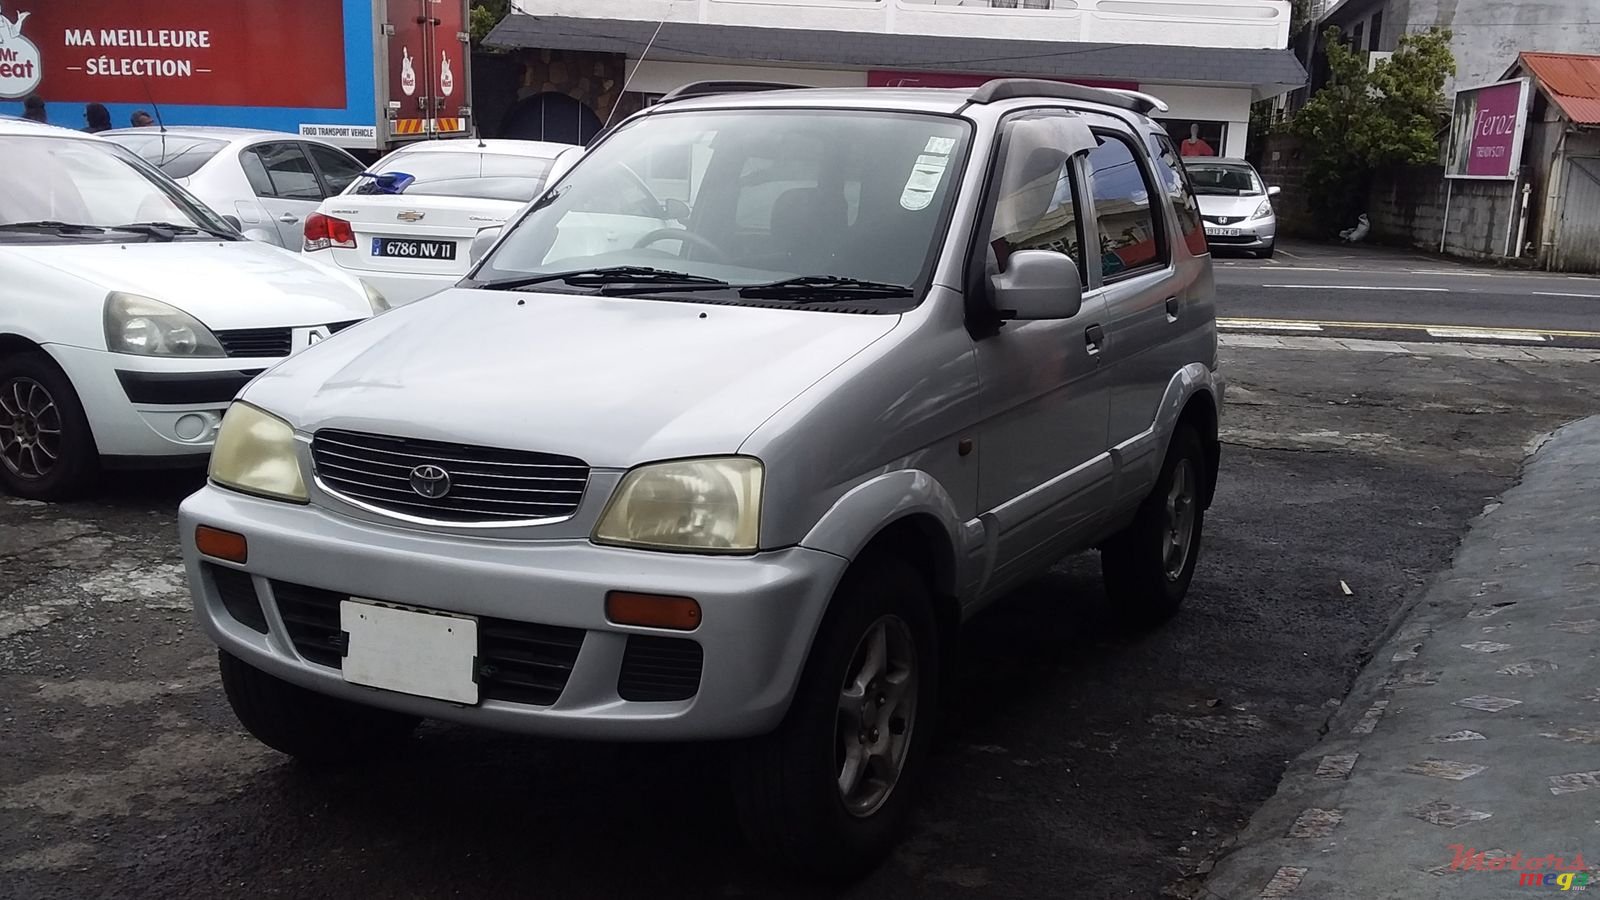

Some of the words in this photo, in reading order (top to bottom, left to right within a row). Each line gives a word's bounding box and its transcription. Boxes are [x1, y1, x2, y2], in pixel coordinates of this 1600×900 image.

[65, 29, 94, 46] MA
[101, 30, 210, 48] MEILLEURE
[0, 48, 18, 62] Mr
[0, 59, 34, 79] eat
[86, 56, 192, 77] SÉLECTION
[302, 127, 317, 136] FOOD
[318, 127, 349, 137] TRANSPORT
[351, 128, 374, 138] VEHICLE
[1474, 109, 1515, 139] Feroz
[386, 241, 417, 256] 6786
[419, 242, 438, 257] NV
[441, 243, 451, 257] 11
